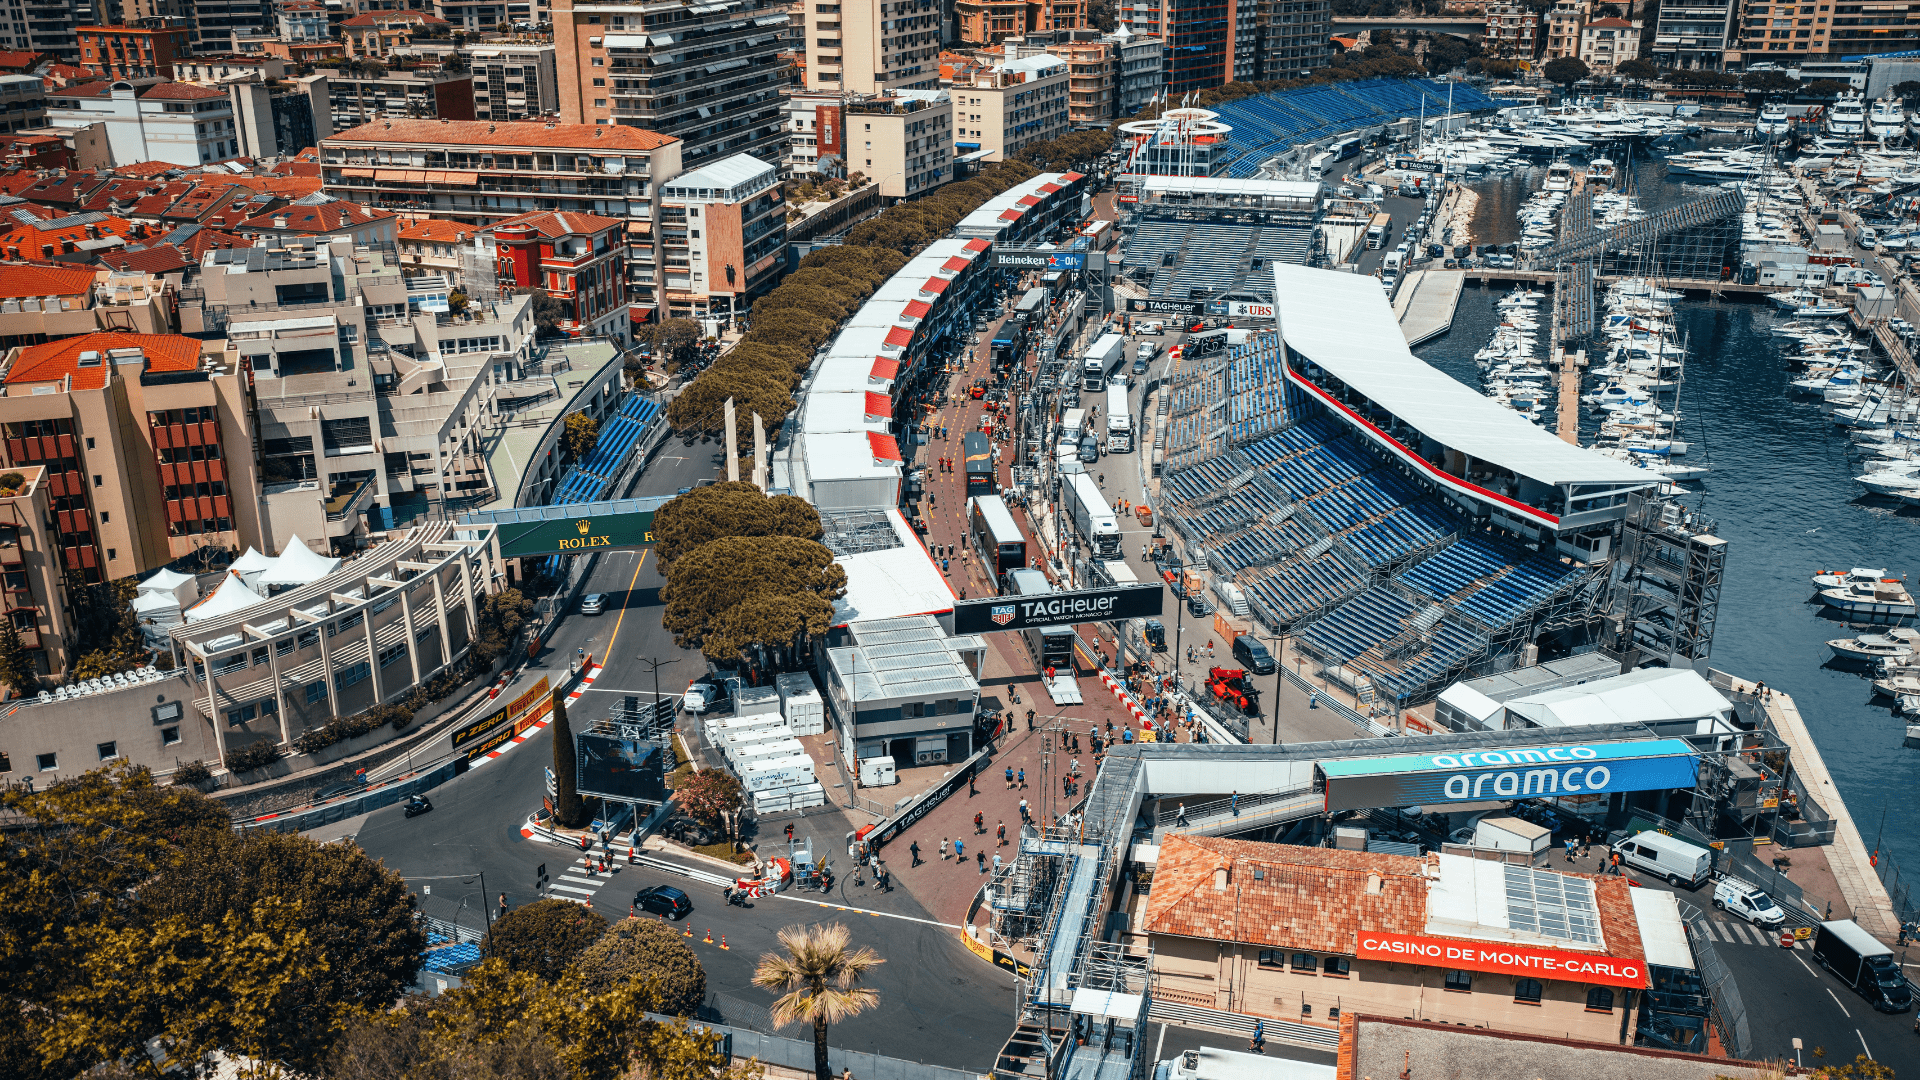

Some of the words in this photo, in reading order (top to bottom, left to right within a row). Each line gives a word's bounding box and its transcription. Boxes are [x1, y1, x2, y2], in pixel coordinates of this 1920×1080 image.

[998, 254, 1045, 266] Heineken
[1148, 301, 1196, 312] TAGHeuer
[1249, 305, 1272, 316] UBS
[558, 535, 611, 550] ROLEX
[995, 606, 1013, 614] TAG
[1021, 596, 1118, 617] TAGHeuer
[992, 612, 1015, 625] HEUER
[1075, 611, 1102, 619] MONACO
[456, 732, 466, 743] P
[468, 711, 505, 737] ZERO
[510, 690, 535, 715] PIRELLI
[468, 748, 478, 758] P
[479, 729, 511, 753] ZERO
[1432, 747, 1597, 768] aramco
[751, 772, 789, 782] LOCAWATT
[1444, 766, 1611, 798] aramco
[900, 783, 953, 827] TAGHeuer
[1363, 939, 1442, 957] CASINO
[1446, 947, 1475, 961] DE
[1480, 951, 1638, 978] MONTE-CARLO
